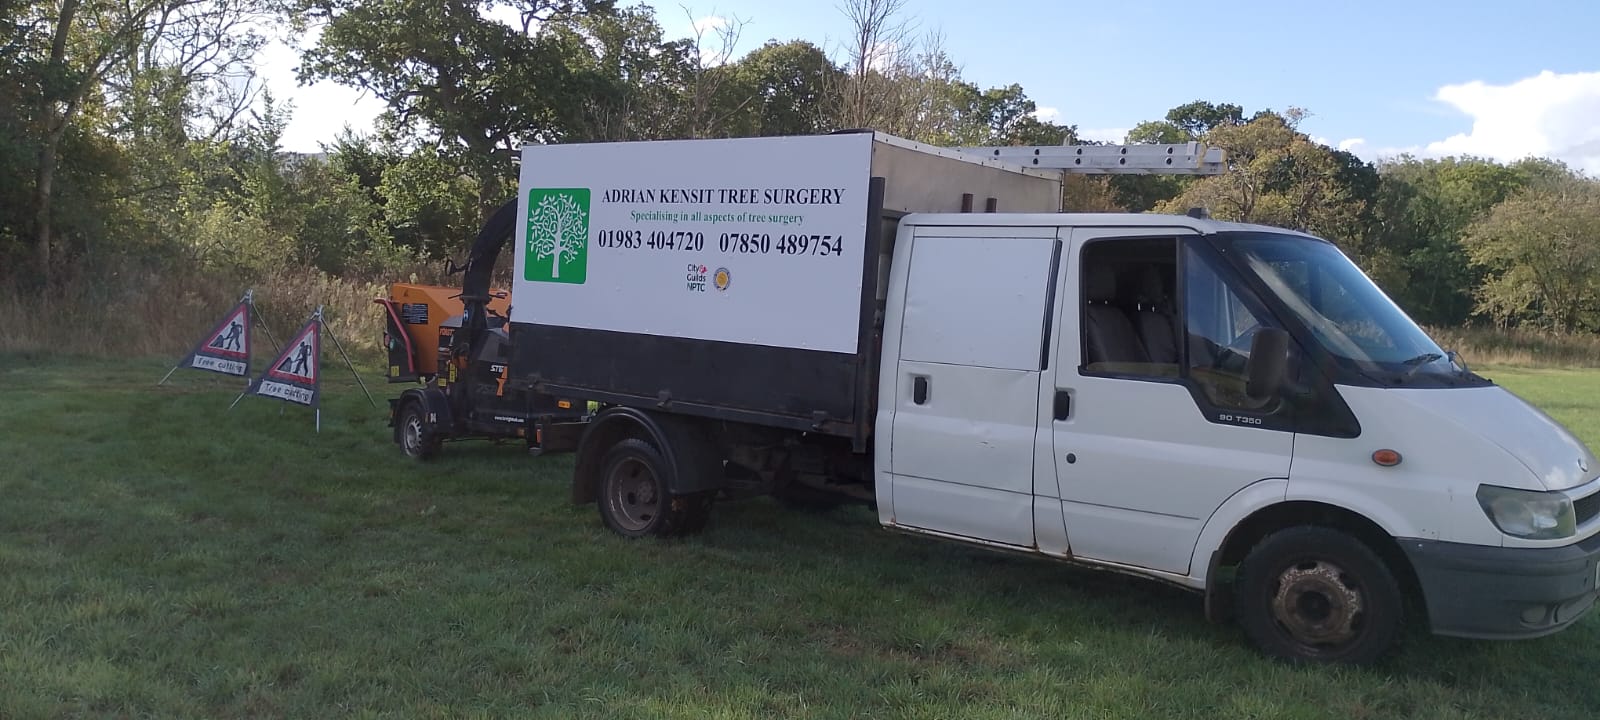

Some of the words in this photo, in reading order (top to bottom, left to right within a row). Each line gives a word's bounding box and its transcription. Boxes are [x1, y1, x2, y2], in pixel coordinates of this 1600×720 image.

[602, 189, 656, 203] ADRIAN
[660, 189, 714, 204] KENSIT
[718, 188, 759, 204] TREE
[764, 188, 846, 205] SURGERY
[630, 210, 678, 224] Specialising
[680, 211, 688, 221] in
[690, 211, 702, 222] all
[704, 213, 735, 224] aspects
[737, 212, 748, 222] of
[748, 213, 766, 222] tree
[768, 214, 804, 226] surgery
[598, 230, 642, 249] 01983
[646, 230, 704, 252] 404720
[719, 232, 770, 254] 07850
[776, 234, 842, 256] 489754
[687, 264, 700, 274] City
[686, 273, 706, 282] Guilds
[686, 282, 706, 292] NPTC
[266, 383, 282, 393] Tree
[284, 386, 310, 401] cutting
[1236, 416, 1262, 424] T350
